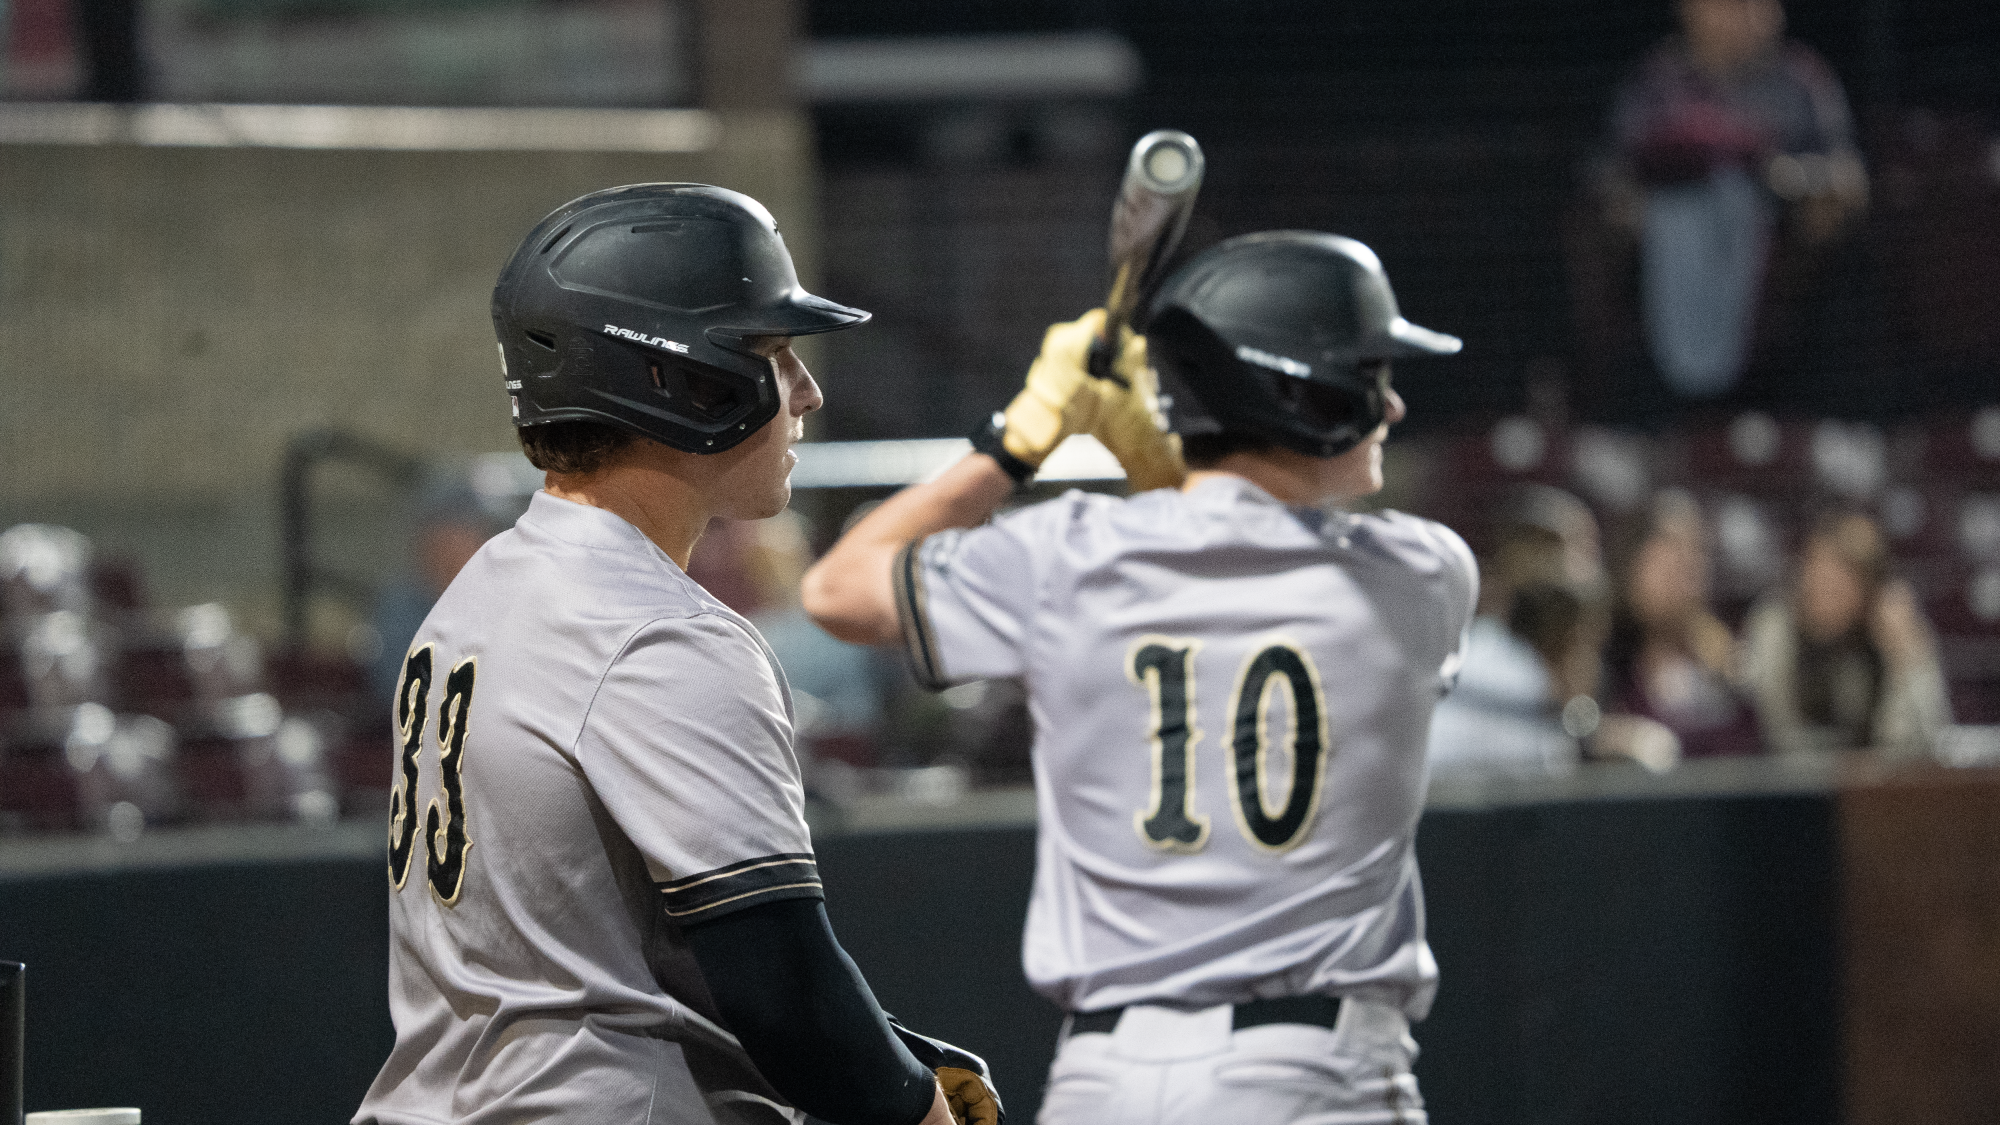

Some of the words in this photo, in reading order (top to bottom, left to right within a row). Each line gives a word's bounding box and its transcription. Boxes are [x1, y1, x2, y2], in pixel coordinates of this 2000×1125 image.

[603, 324, 690, 354] RAWLINGS
[388, 641, 478, 907] 33
[1124, 633, 1330, 854] 10
